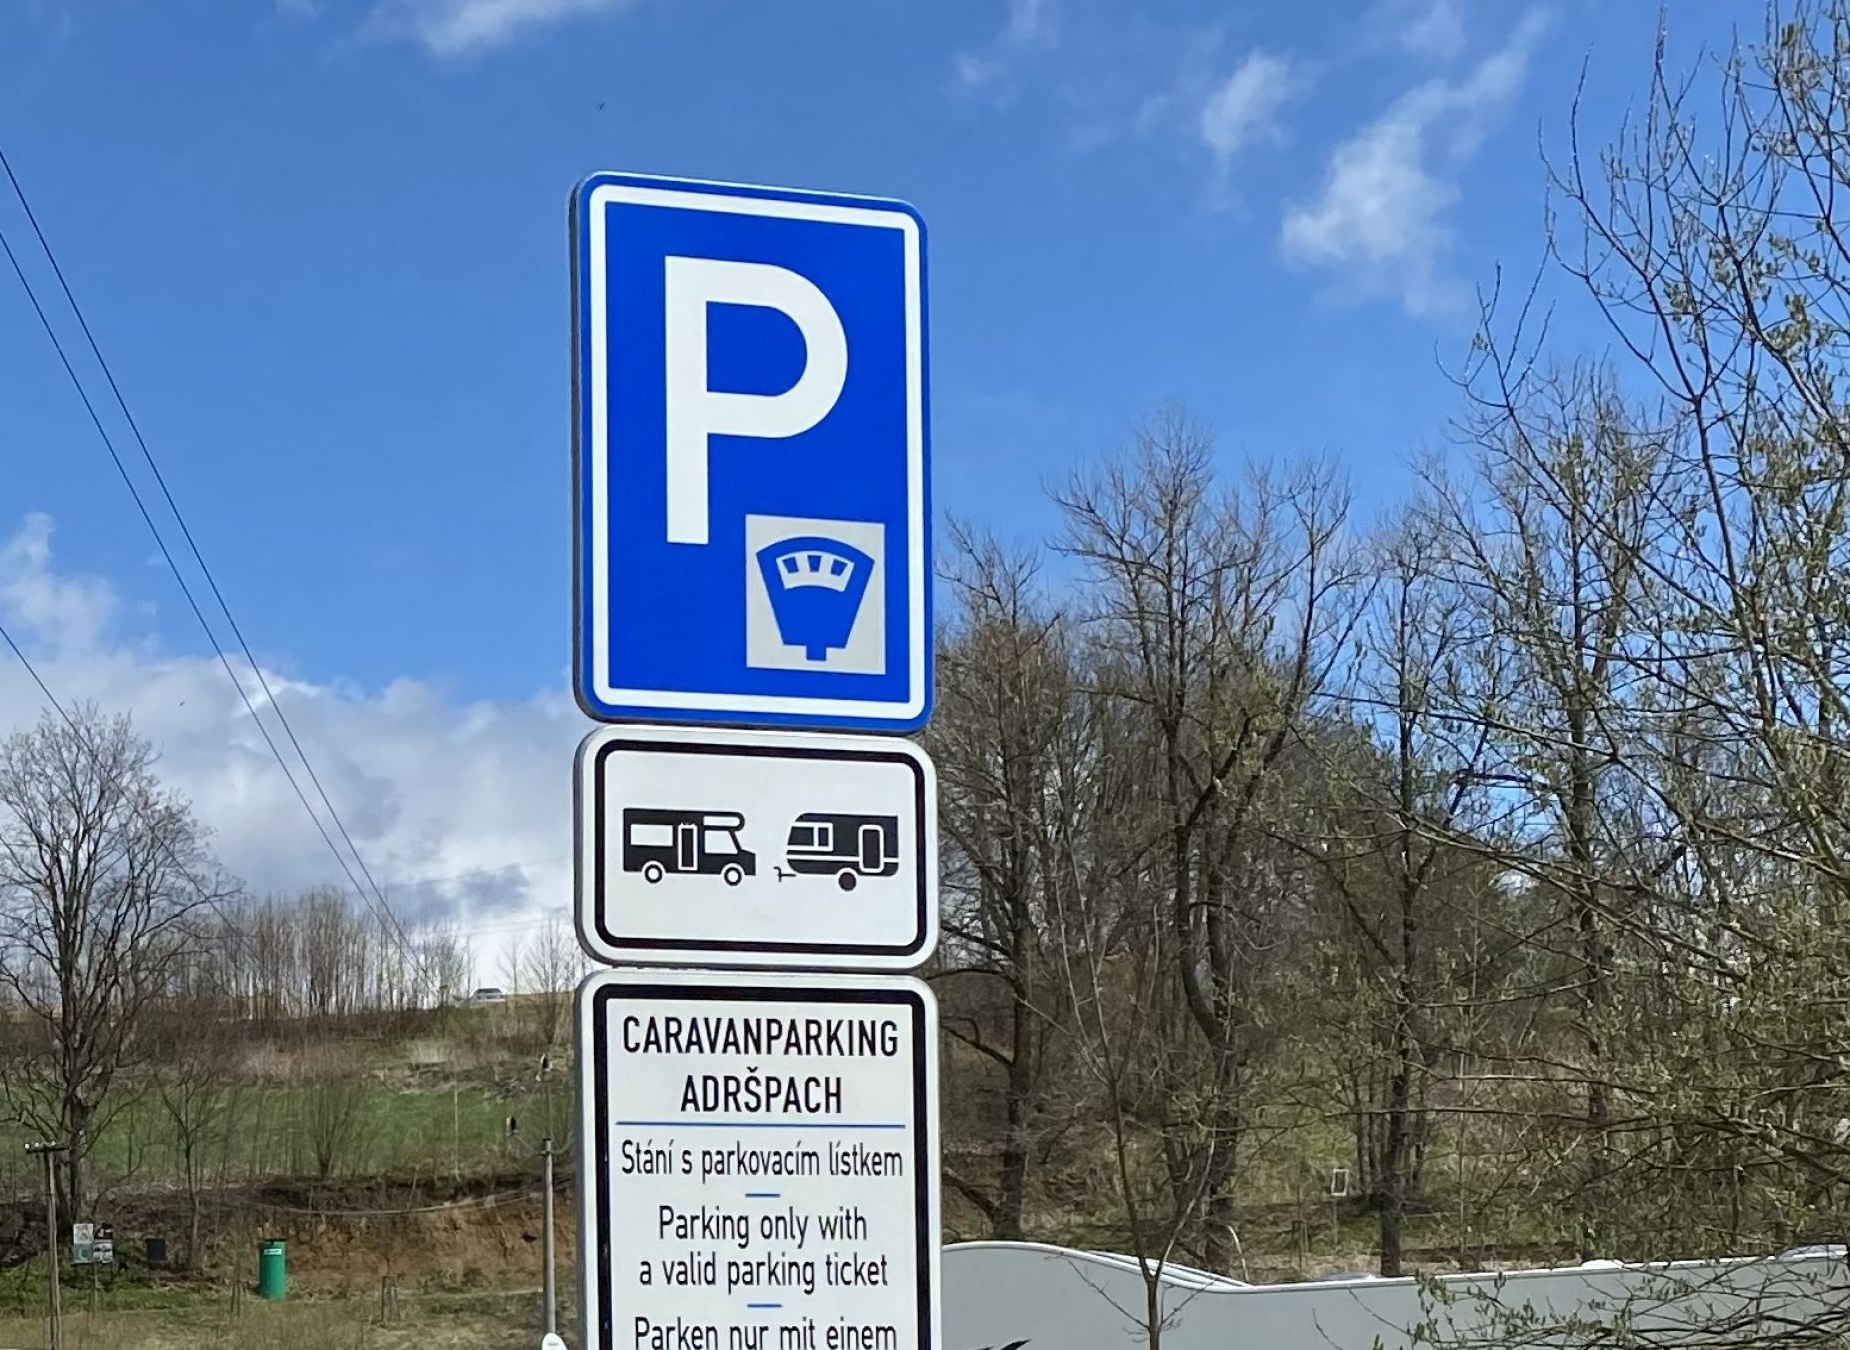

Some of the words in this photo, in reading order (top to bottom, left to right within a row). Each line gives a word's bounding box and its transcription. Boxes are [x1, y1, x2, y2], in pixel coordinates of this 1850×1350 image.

[664, 256, 849, 545] P
[623, 1015, 898, 1057] CARAVANPARKING
[680, 1065, 842, 1114] ADRŠPACH
[621, 1138, 675, 1175] Stání
[681, 1149, 693, 1175] s
[701, 1140, 820, 1185] parkovacím
[829, 1140, 903, 1177] lístkem
[658, 1205, 750, 1249] Parking
[760, 1205, 809, 1249] only
[817, 1205, 867, 1241] with
[639, 1260, 652, 1286] a
[661, 1250, 717, 1286] valid
[727, 1251, 815, 1296] parking
[825, 1251, 888, 1287] ticket
[634, 1316, 719, 1350] Parken
[729, 1325, 770, 1350] nur
[779, 1316, 816, 1350] mit
[826, 1316, 897, 1350] einem
